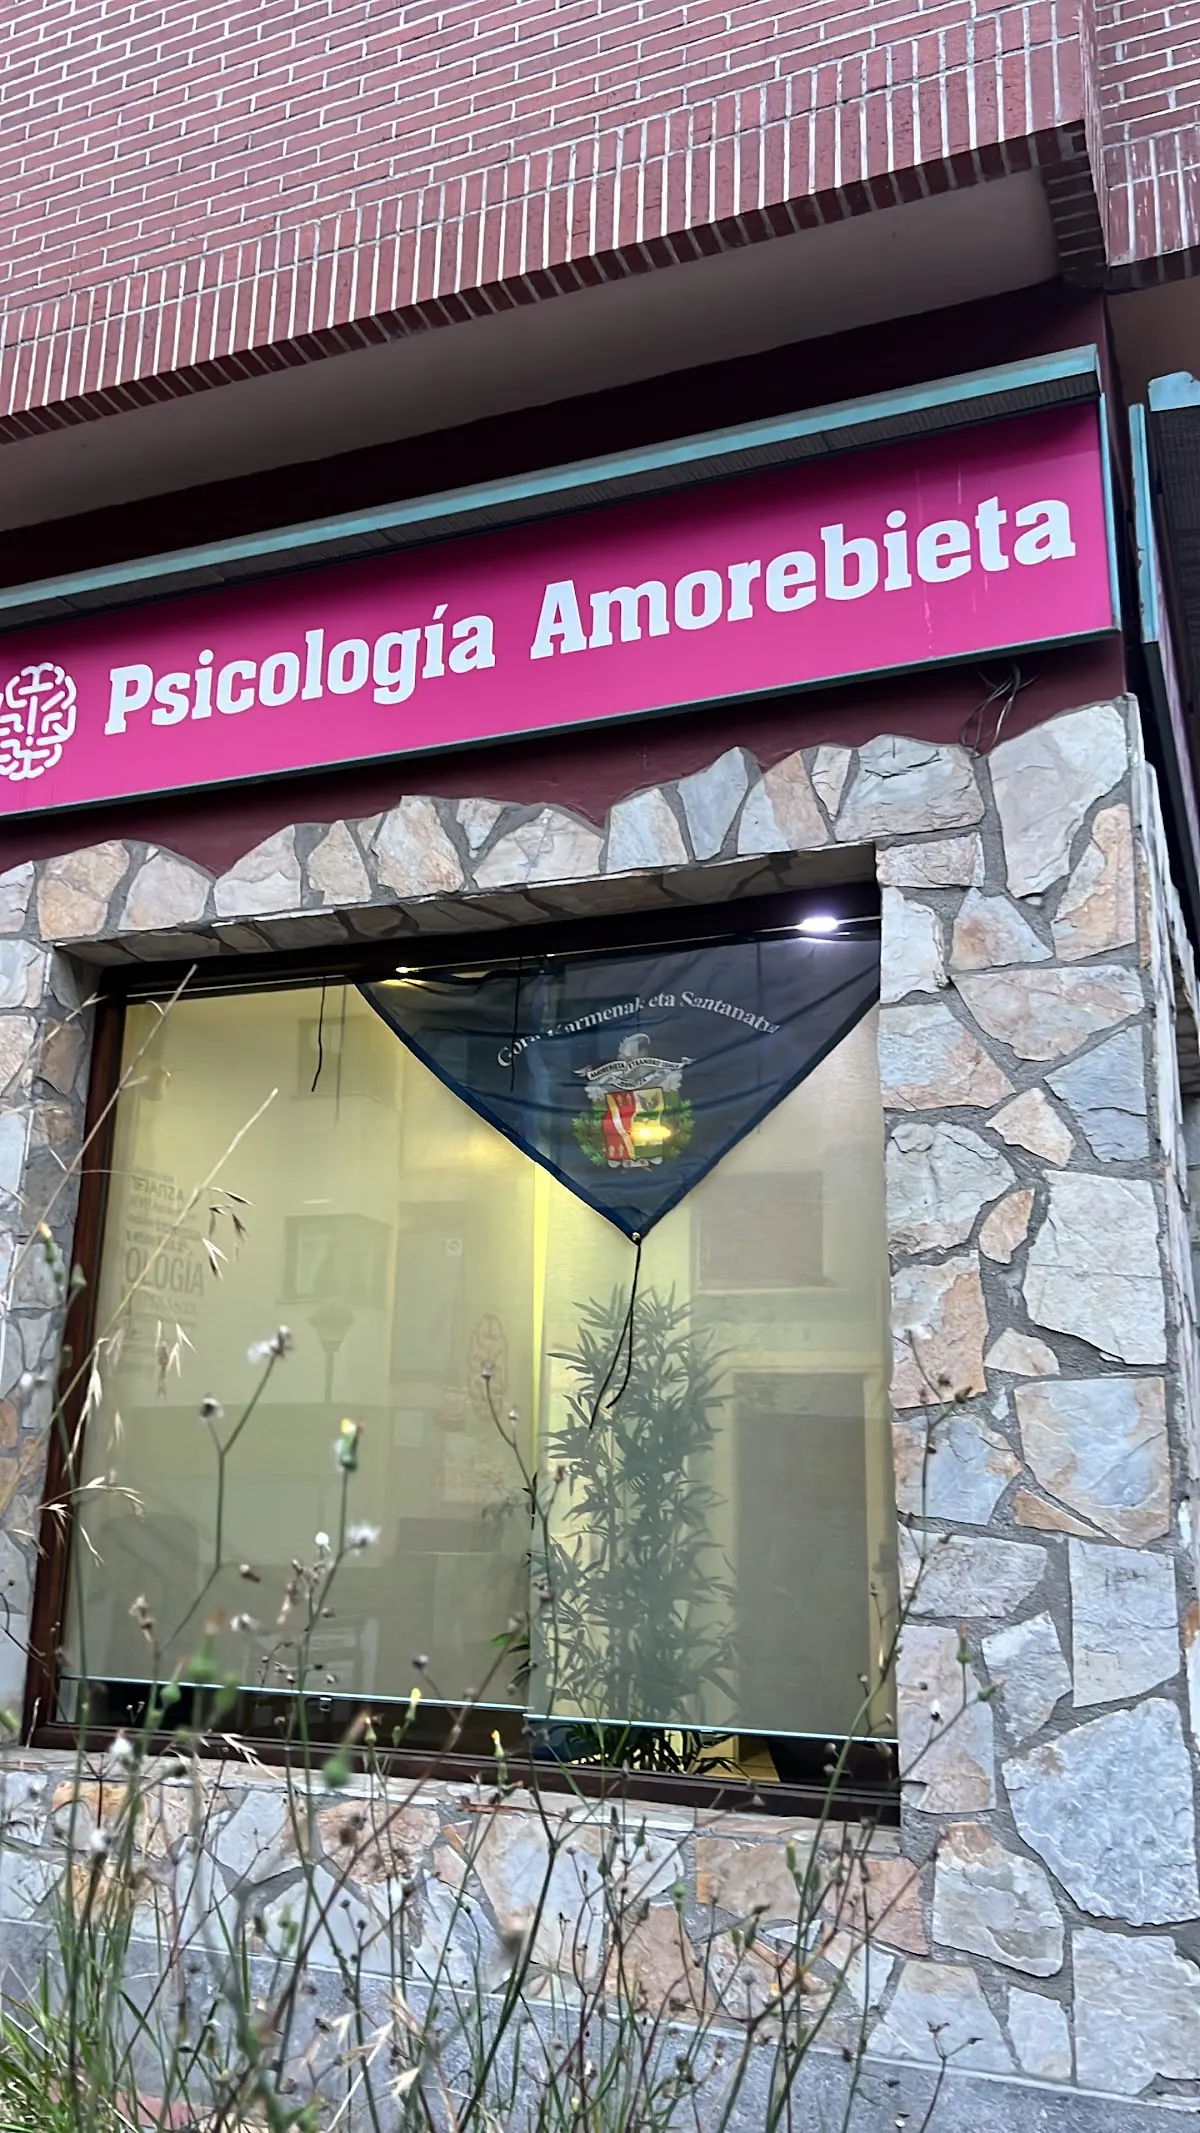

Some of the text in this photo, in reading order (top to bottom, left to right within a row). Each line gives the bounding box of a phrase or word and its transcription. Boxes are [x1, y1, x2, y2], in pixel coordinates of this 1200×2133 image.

[104, 496, 1076, 735] Psicología Amorebieta
[648, 991, 675, 1008] eta
